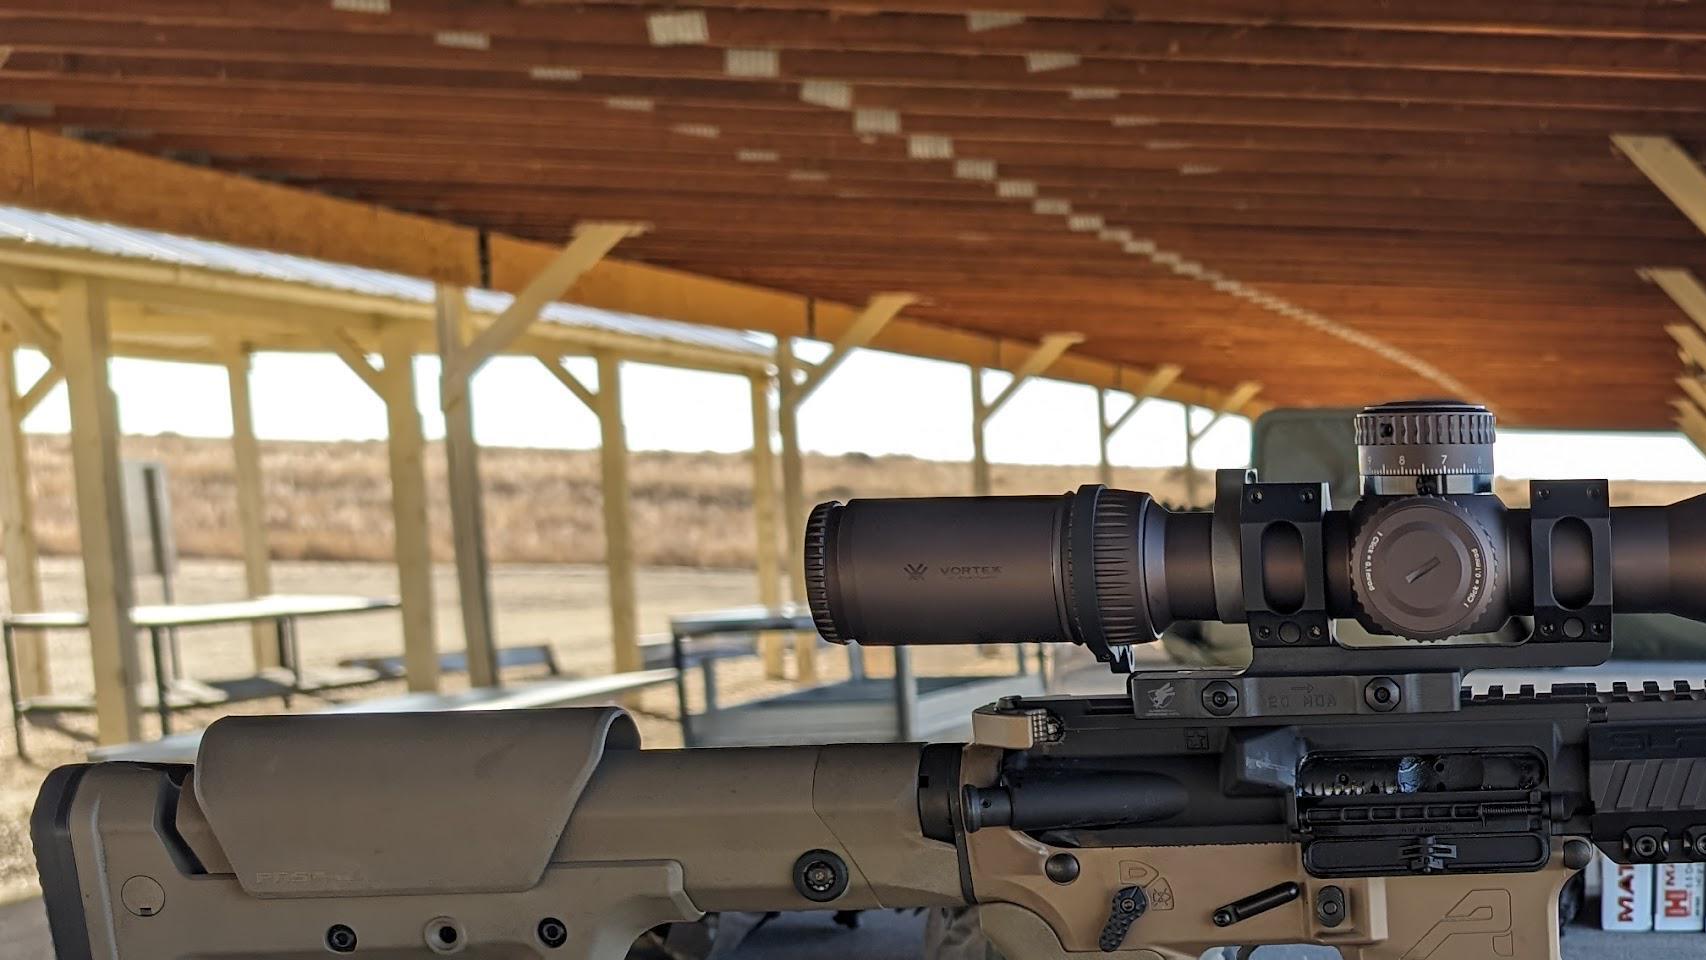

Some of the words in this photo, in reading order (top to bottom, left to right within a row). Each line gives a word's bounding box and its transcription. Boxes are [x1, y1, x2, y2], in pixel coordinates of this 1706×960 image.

[1398, 455, 1406, 464] 8
[1441, 454, 1448, 464] 7
[940, 565, 1002, 575] VORTEX
